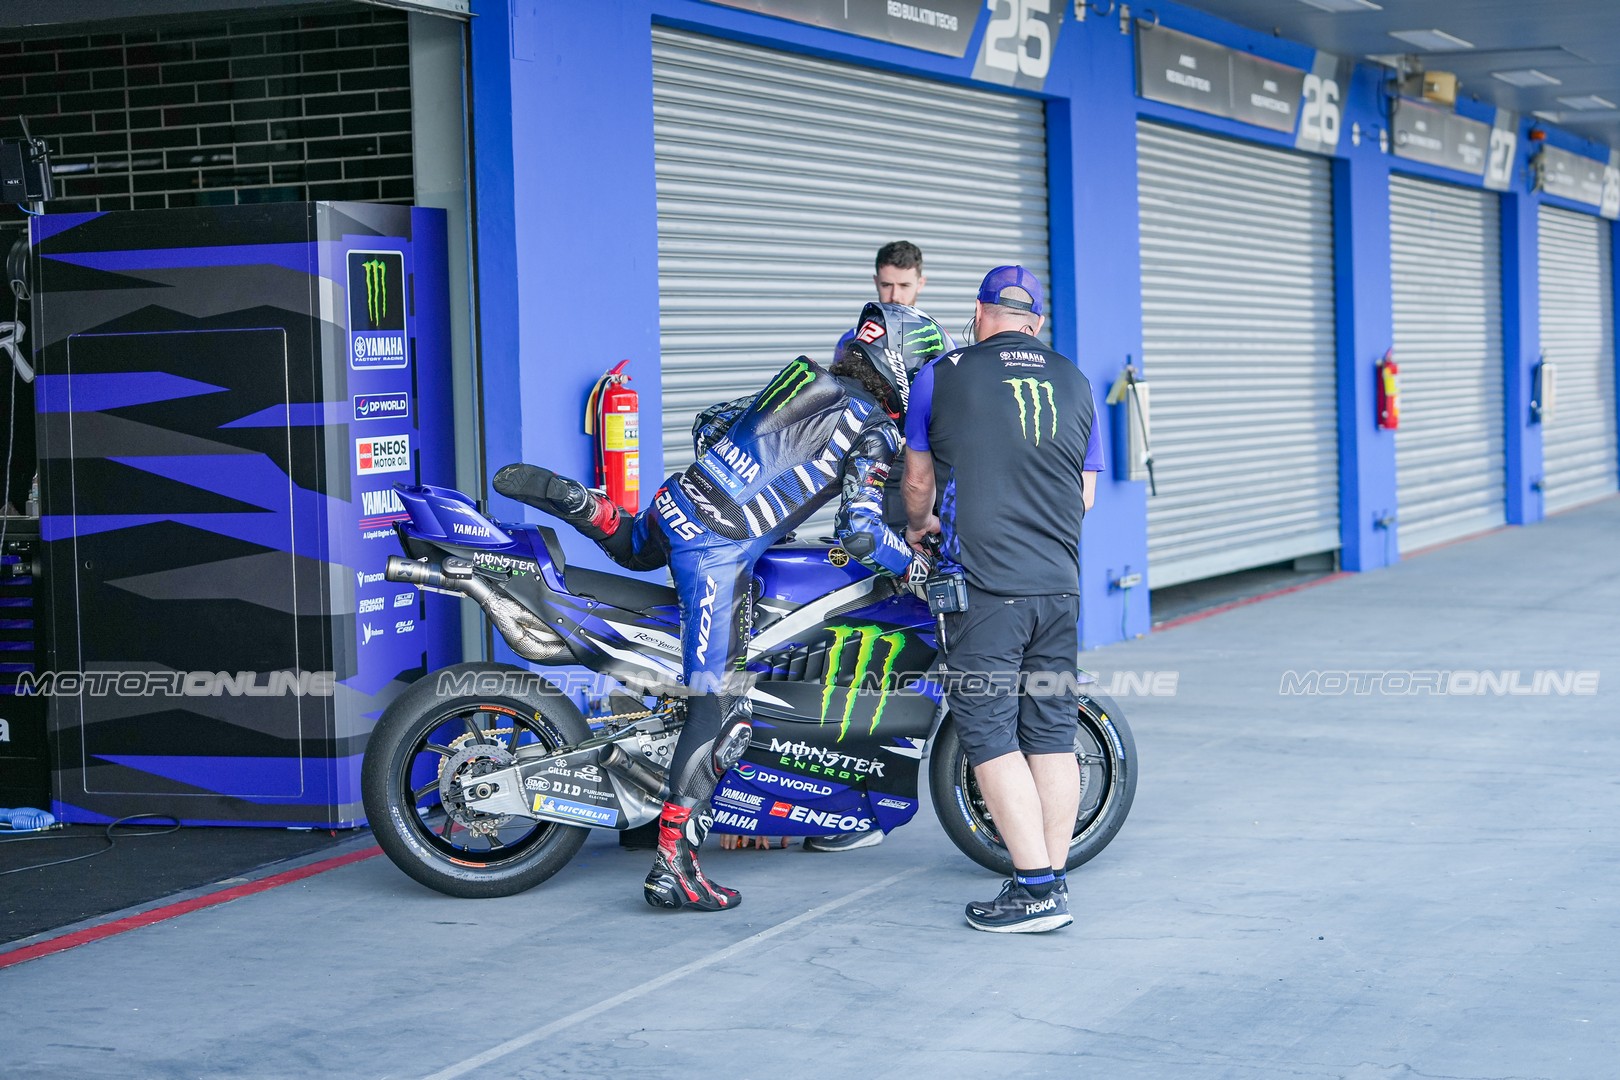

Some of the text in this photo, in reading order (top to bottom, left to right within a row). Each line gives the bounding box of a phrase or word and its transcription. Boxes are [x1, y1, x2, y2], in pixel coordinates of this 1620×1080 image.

[985, 0, 1051, 78] 25
[1302, 73, 1340, 146] 26
[1489, 128, 1516, 181] 27
[365, 337, 403, 356] YAMAHA
[1010, 351, 1046, 364] YAMAHA
[369, 400, 406, 412] DP WORLD
[373, 440, 406, 457] ENEOS
[374, 456, 407, 468] MOTOR OIL
[704, 460, 737, 489] MICHELIN
[361, 489, 406, 516] YAMALUB
[453, 523, 490, 537] YAMAHA
[473, 552, 535, 573] MONSTER
[481, 564, 527, 577] ENEGY
[364, 573, 385, 584] macron
[633, 631, 659, 643] Revs
[769, 737, 885, 777] MONSTER
[548, 766, 571, 777] GILLES
[574, 771, 602, 783] RCB
[779, 756, 866, 782] ENERGY
[527, 778, 549, 789] BMC
[552, 781, 581, 796] D.I.D
[757, 772, 832, 796] DP WORLD
[721, 787, 763, 806] YAMALUBE
[557, 804, 611, 820] MICHELIN
[712, 808, 758, 831] MAHA
[788, 806, 872, 832] ENEOS
[1026, 898, 1056, 915] HOKA
